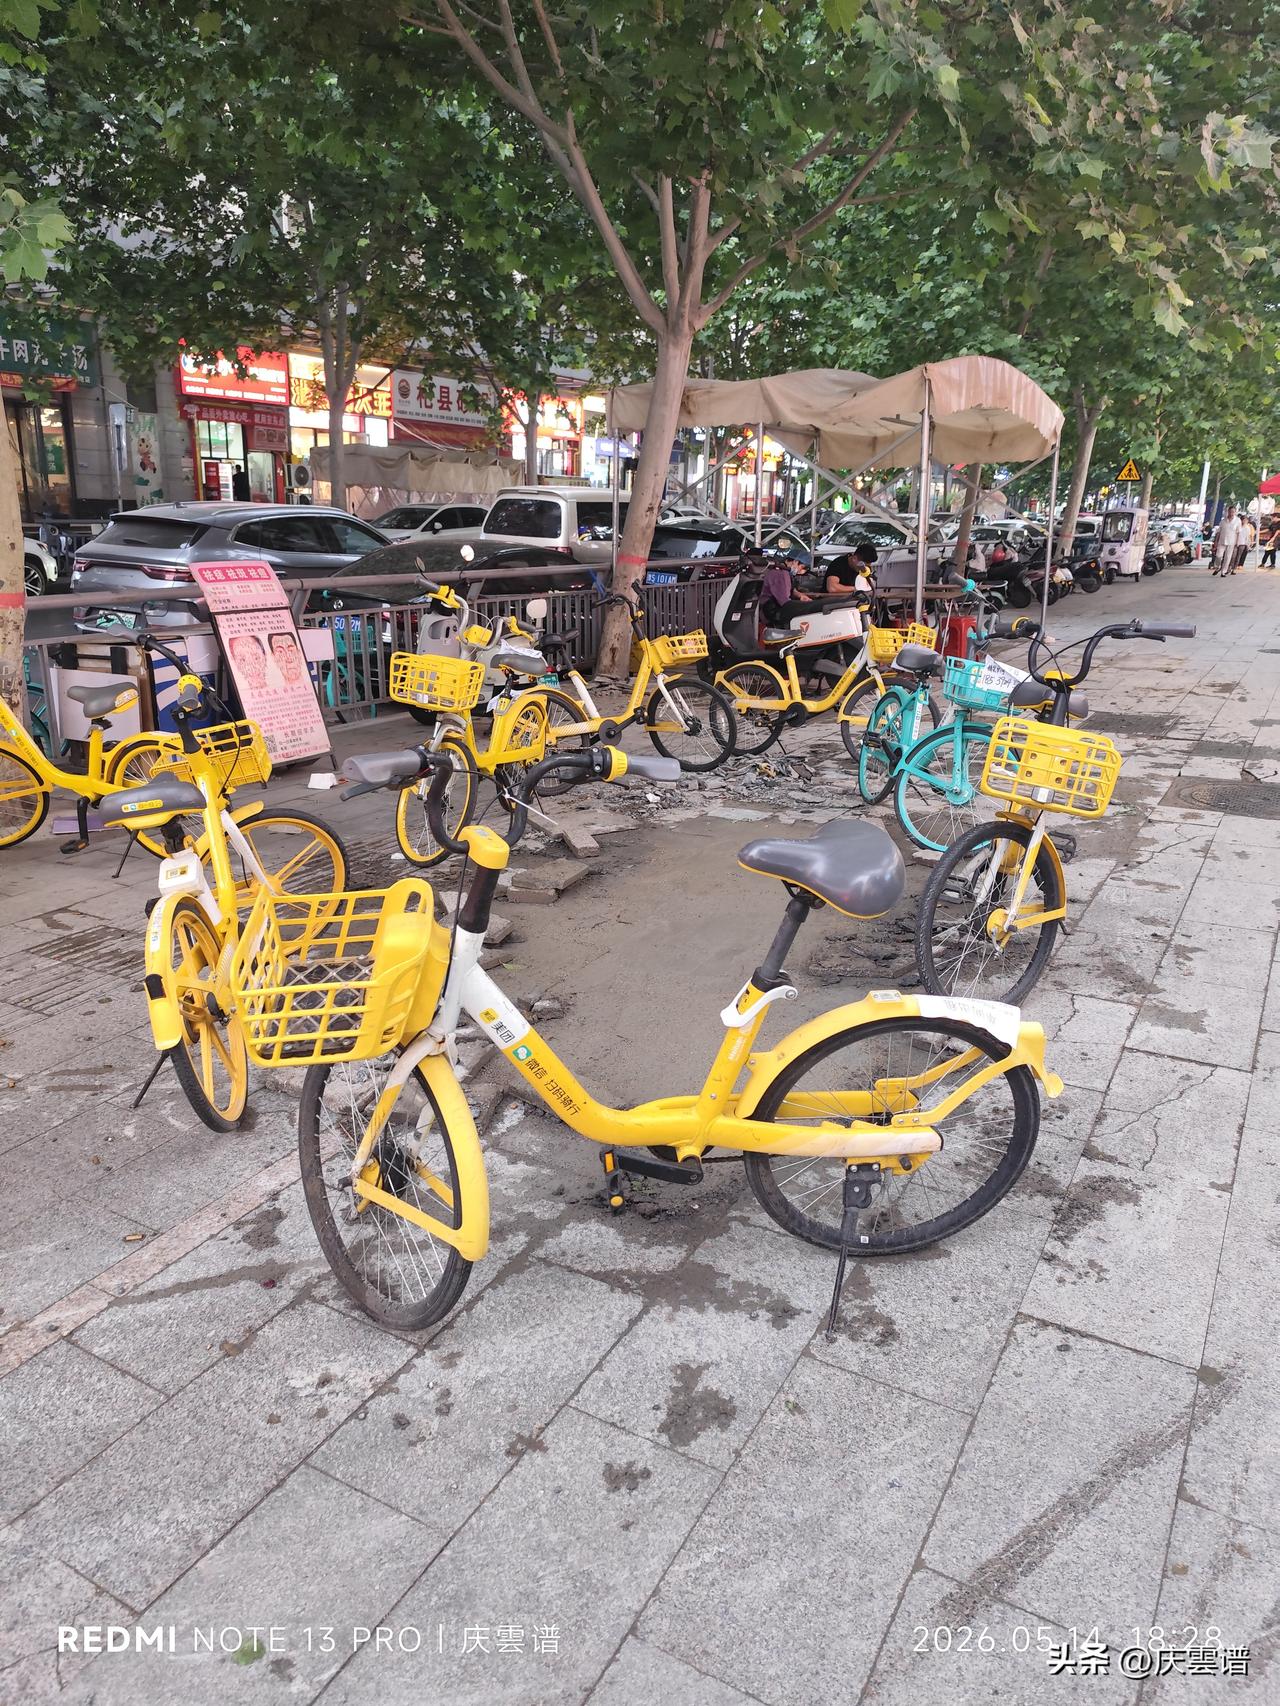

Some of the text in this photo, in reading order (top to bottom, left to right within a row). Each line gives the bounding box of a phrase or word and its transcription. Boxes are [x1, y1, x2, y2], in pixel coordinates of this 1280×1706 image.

[491, 1021, 515, 1043] 美团
[525, 1058, 581, 1116] 微信 扫码骑行
